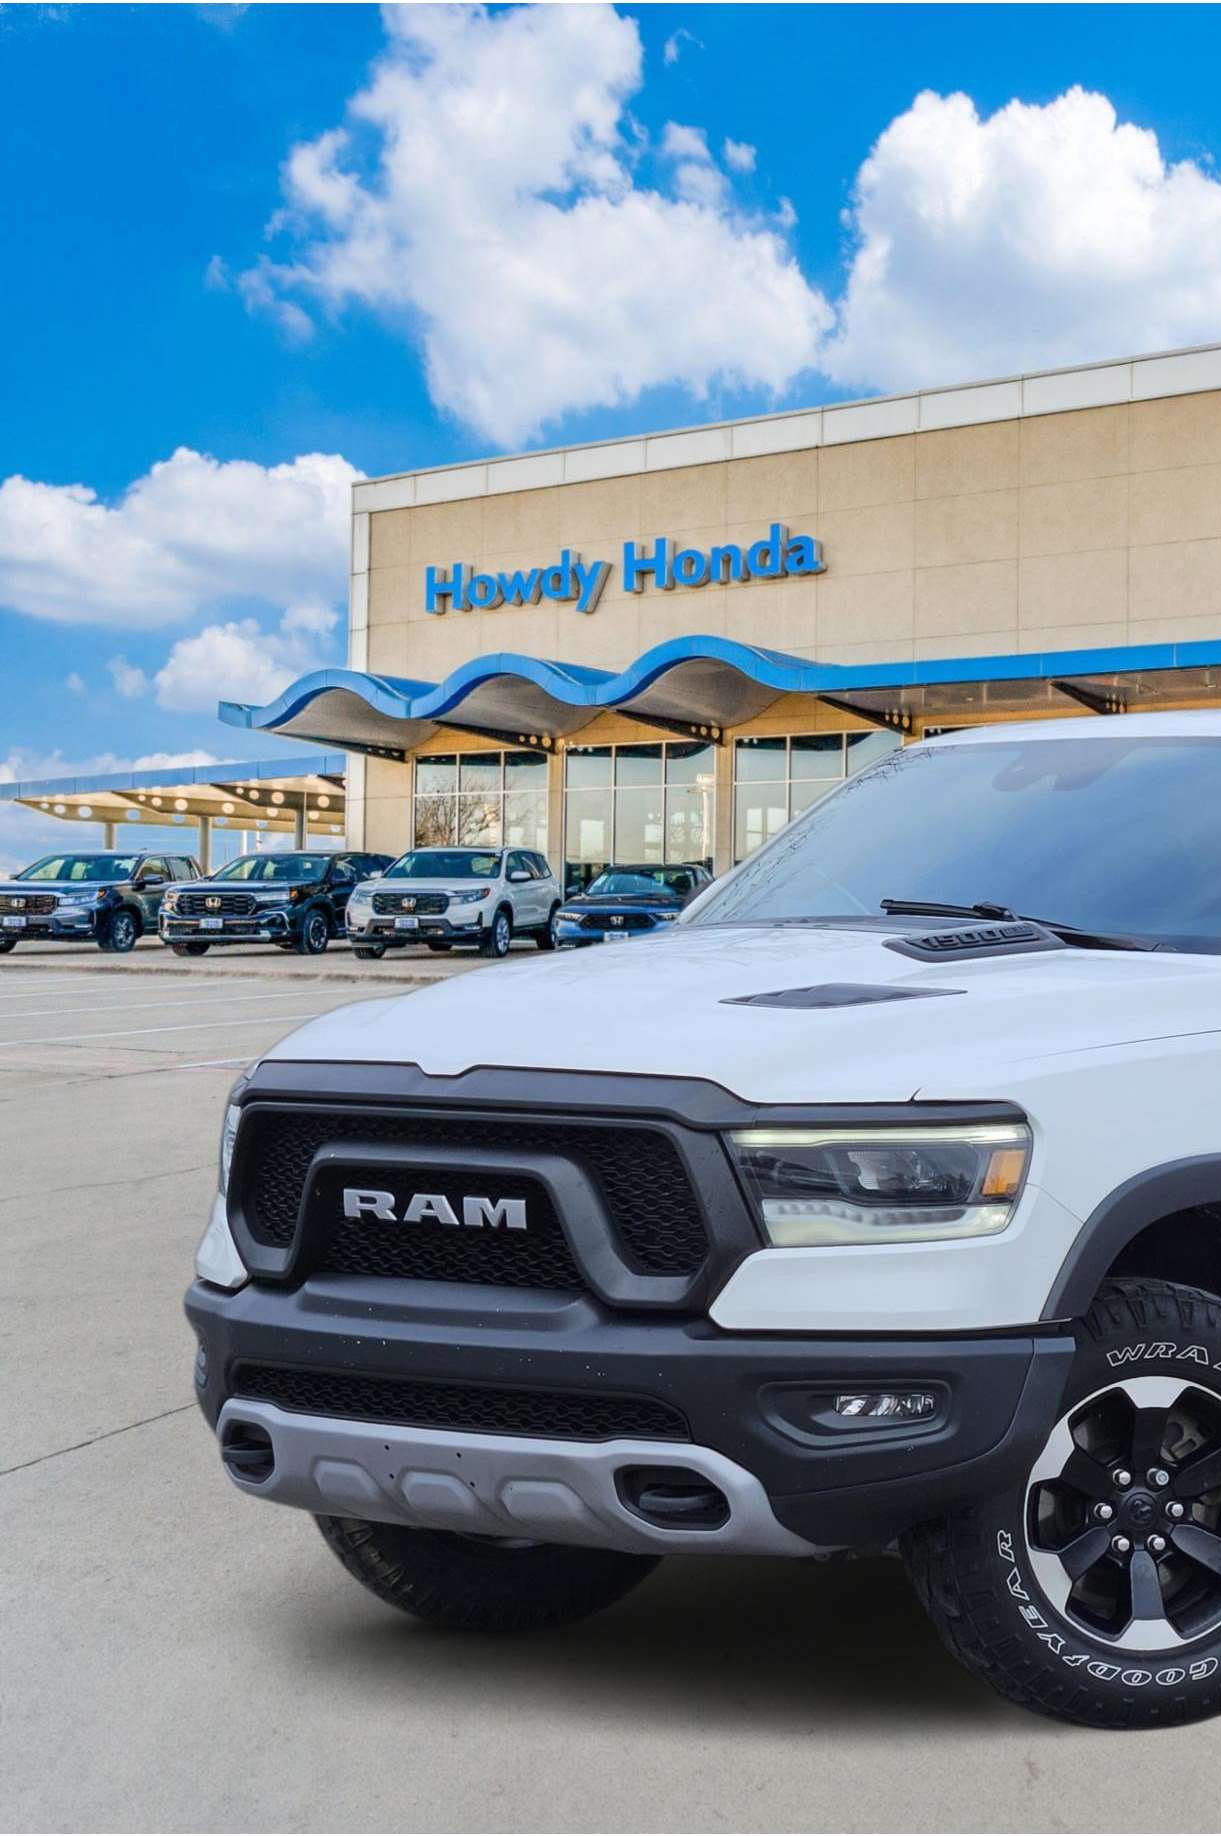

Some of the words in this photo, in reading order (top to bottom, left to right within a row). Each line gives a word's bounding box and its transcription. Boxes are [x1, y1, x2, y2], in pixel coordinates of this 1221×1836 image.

[424, 548, 612, 615] Howdy
[623, 522, 827, 594] Honda
[343, 1188, 527, 1230] RAM
[997, 1529, 1219, 1687] GOODYEAR
